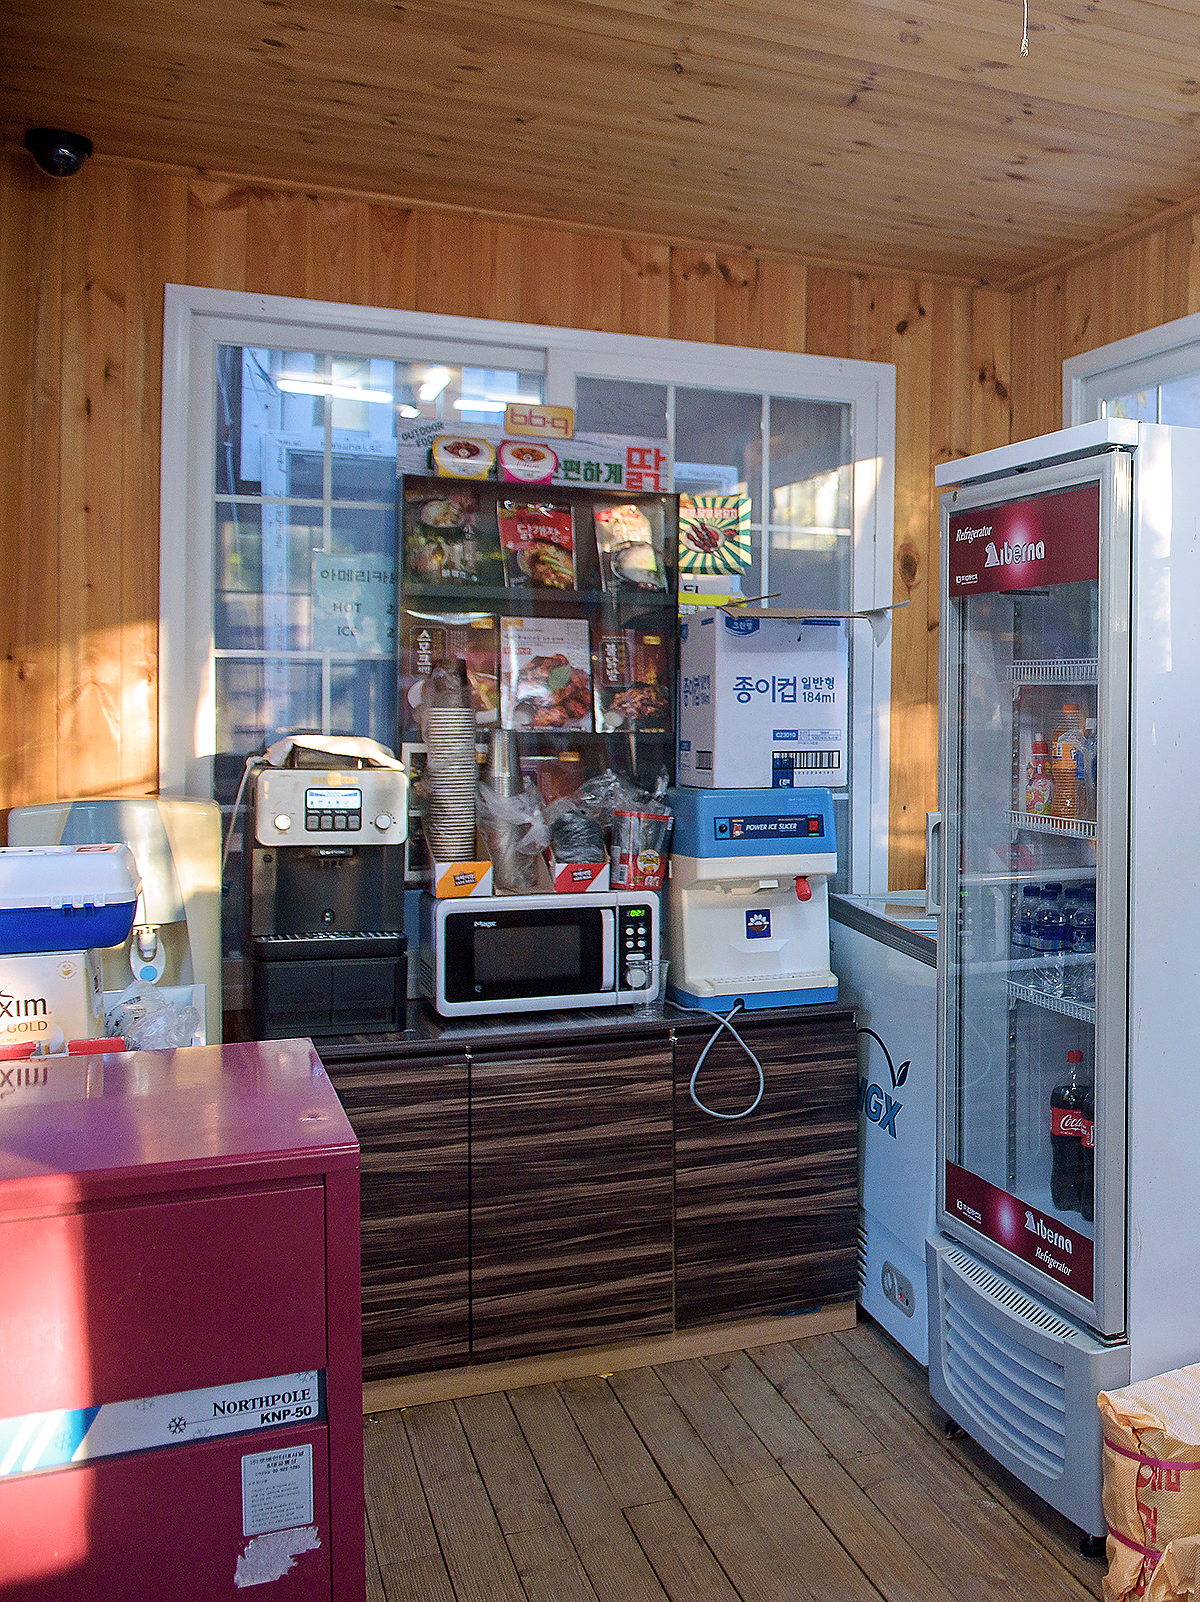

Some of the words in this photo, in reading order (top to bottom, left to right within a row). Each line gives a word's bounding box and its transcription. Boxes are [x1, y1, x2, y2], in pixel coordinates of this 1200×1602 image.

[554, 458, 623, 485] 편하게
[955, 525, 993, 543] Refrigerator
[332, 602, 362, 613] HOT
[732, 675, 797, 704] 종이컵
[801, 676, 835, 691] 일반형
[802, 691, 836, 703] 184ml
[768, 823, 778, 831] ICE
[778, 823, 798, 831] SLICER
[6, 1020, 48, 1034] GOLD
[1035, 1246, 1073, 1277] Refrigerator
[212, 1388, 311, 1417] NORTHPOLE
[260, 1405, 313, 1425] KNP-50
